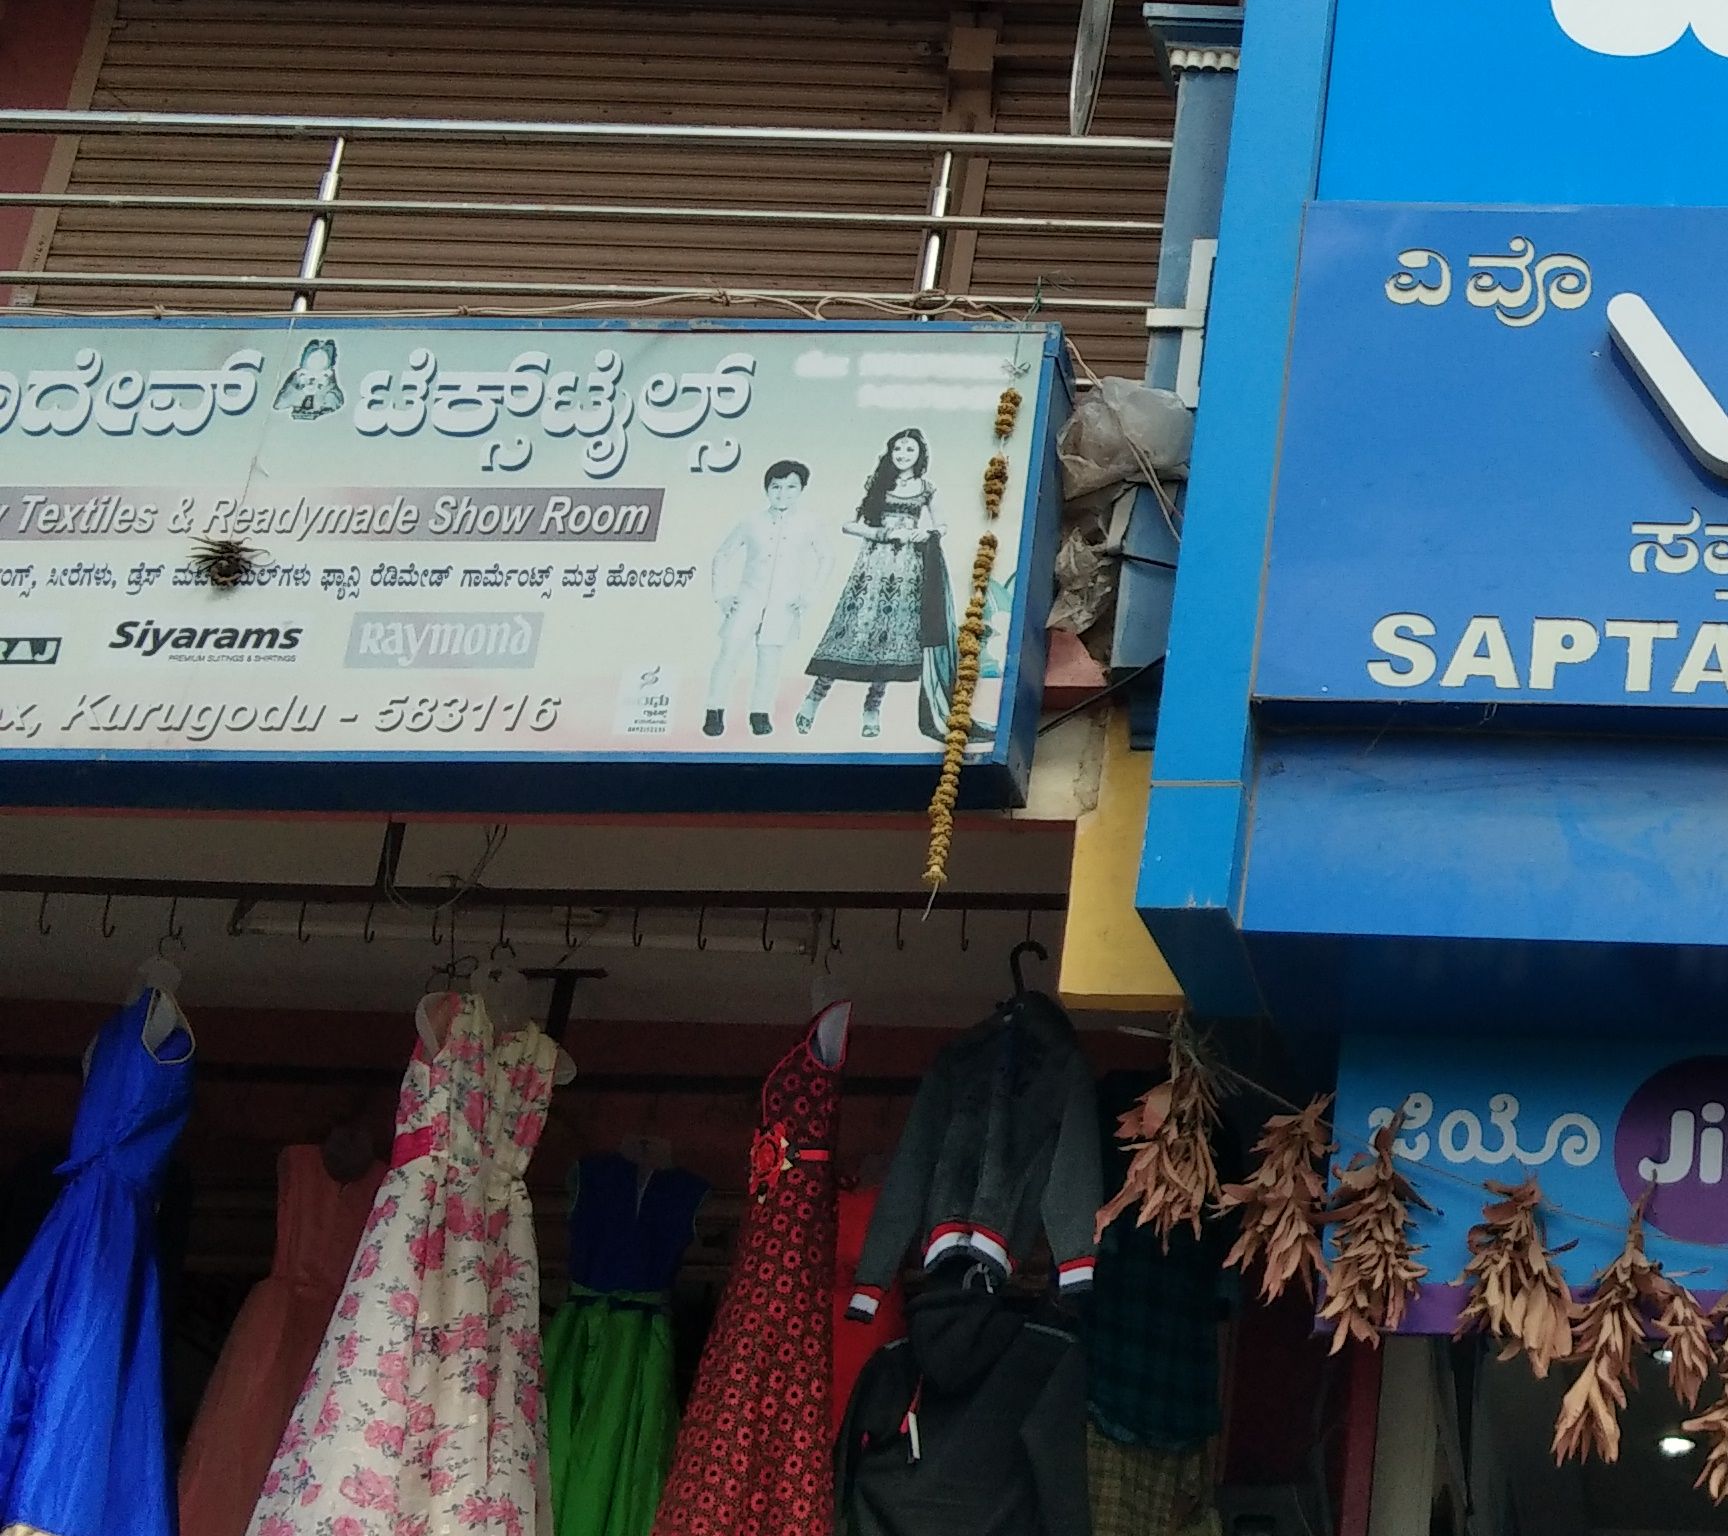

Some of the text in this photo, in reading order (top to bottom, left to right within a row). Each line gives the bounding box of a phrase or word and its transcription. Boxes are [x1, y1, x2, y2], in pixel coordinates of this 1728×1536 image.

[18, 494, 158, 534] Textiles
[166, 497, 195, 535] &
[202, 495, 420, 543] Readymade
[428, 495, 535, 536] Show
[539, 496, 650, 535] Room
[109, 620, 303, 657] Siyarams
[357, 613, 536, 666] Raymond
[60, 693, 327, 741] Kurugodu
[373, 694, 563, 733] 583116
